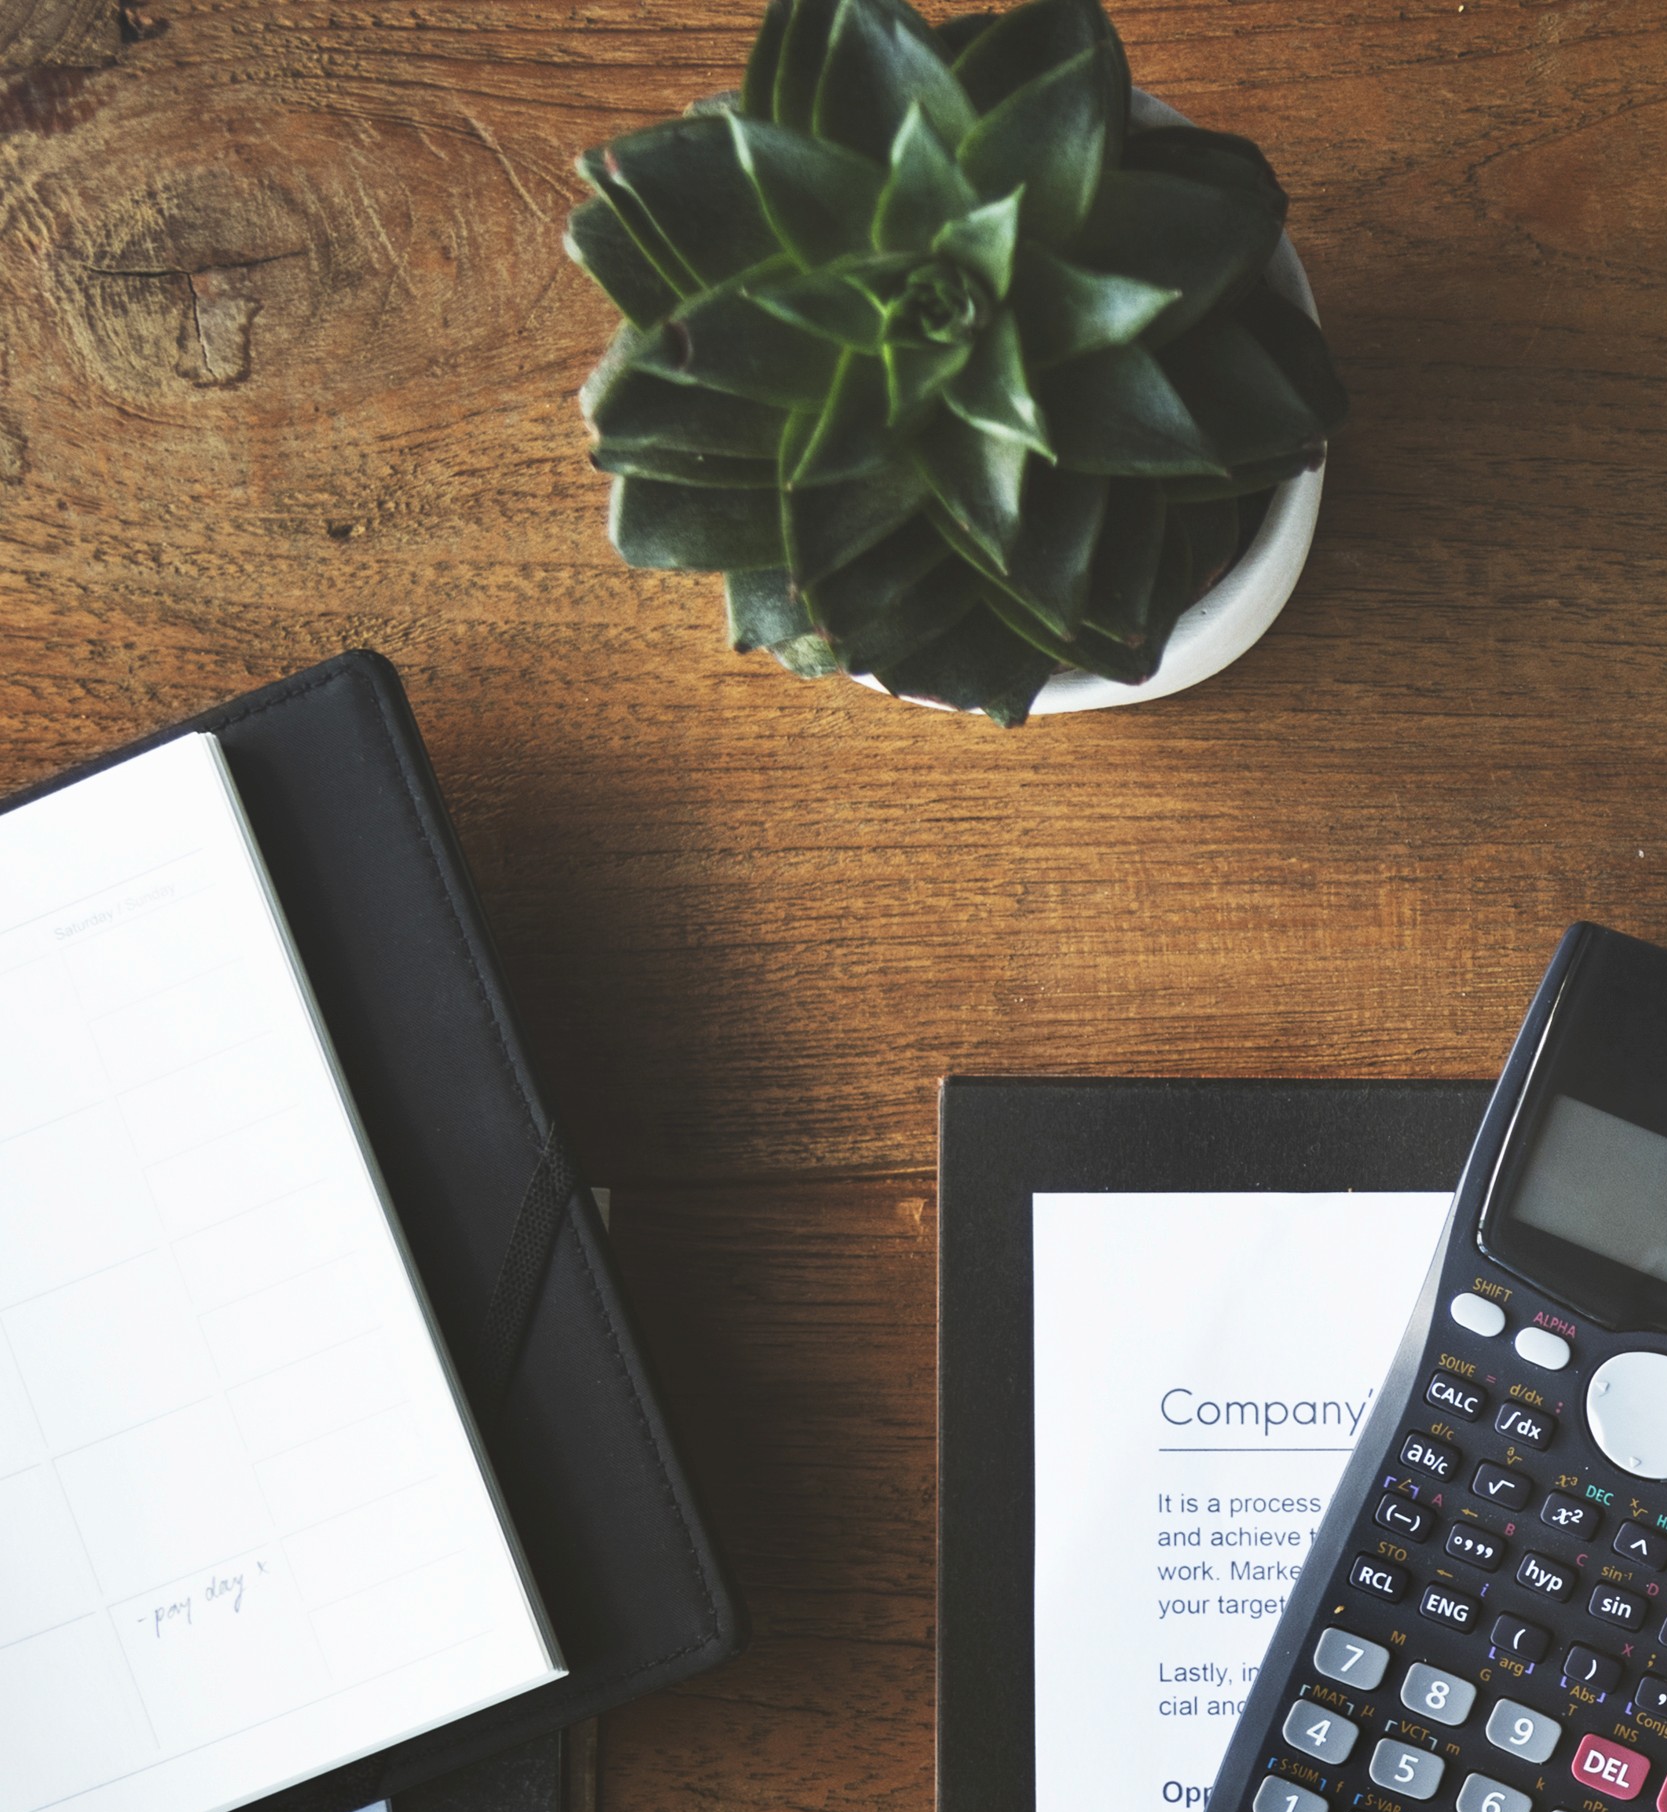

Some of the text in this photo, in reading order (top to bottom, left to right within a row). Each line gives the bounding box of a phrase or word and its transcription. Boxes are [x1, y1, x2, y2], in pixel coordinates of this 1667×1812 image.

[1472, 1277, 1513, 1303] SHIFT
[1533, 1311, 1577, 1338] ALPHA
[1438, 1353, 1476, 1378] SOLVE
[1430, 1382, 1478, 1413] CALC
[1161, 1388, 1373, 1436] Company'
[1586, 1484, 1615, 1506] DEC
[1377, 1541, 1407, 1561] STO
[1358, 1566, 1394, 1594] RCL
[1526, 1560, 1563, 1591] hyp
[1426, 1594, 1469, 1622] ENG
[1601, 1597, 1632, 1618] sin
[1341, 1645, 1364, 1673] 7
[1425, 1681, 1450, 1709] 8
[1306, 1720, 1331, 1746] 4
[1509, 1717, 1534, 1745] 9
[1394, 1754, 1419, 1782] 5
[1583, 1749, 1630, 1788] DEL
